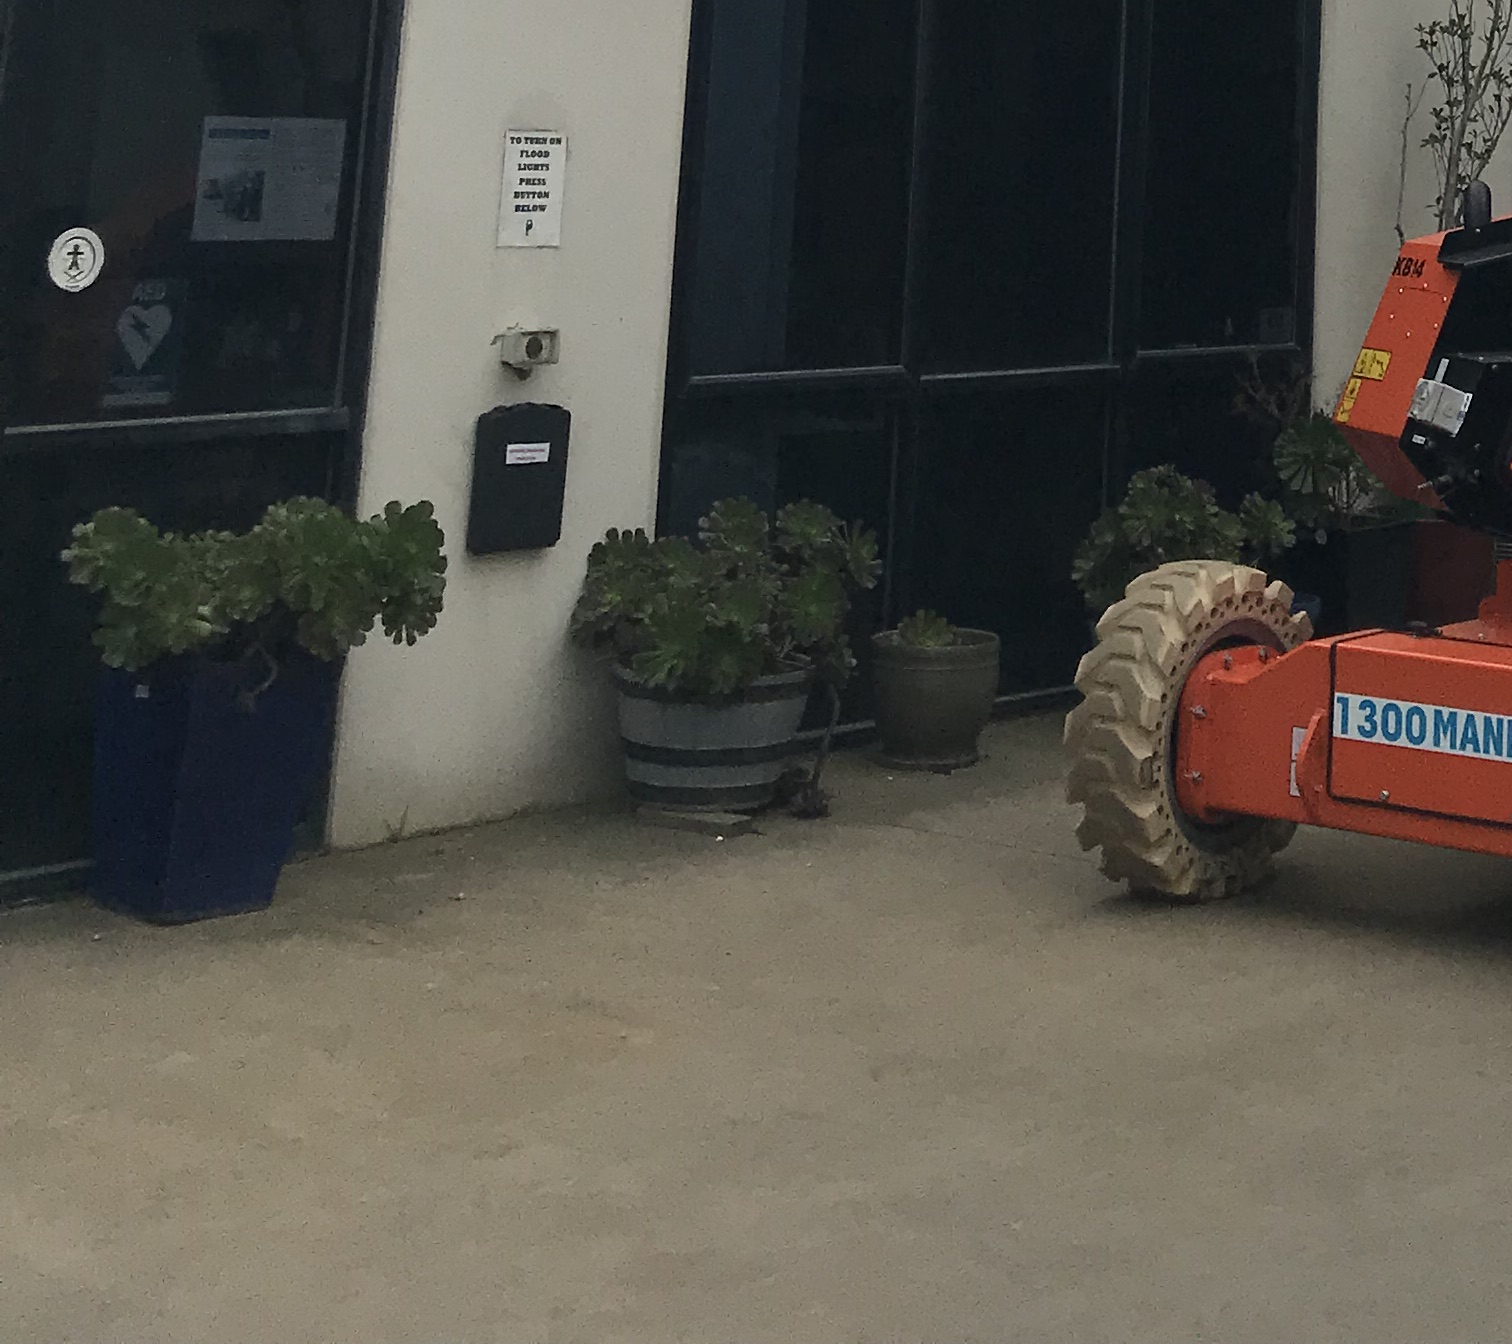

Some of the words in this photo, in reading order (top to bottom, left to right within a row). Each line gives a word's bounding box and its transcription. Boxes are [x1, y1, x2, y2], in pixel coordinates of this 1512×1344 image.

[510, 136, 522, 144] TO
[549, 137, 562, 145] ON
[519, 150, 550, 158] FLOOD
[517, 163, 550, 171] LIGHTS
[518, 177, 547, 185] PRESS
[513, 191, 550, 199] BUTTON
[514, 204, 548, 212] BELOW
[1391, 256, 1427, 278] KB14
